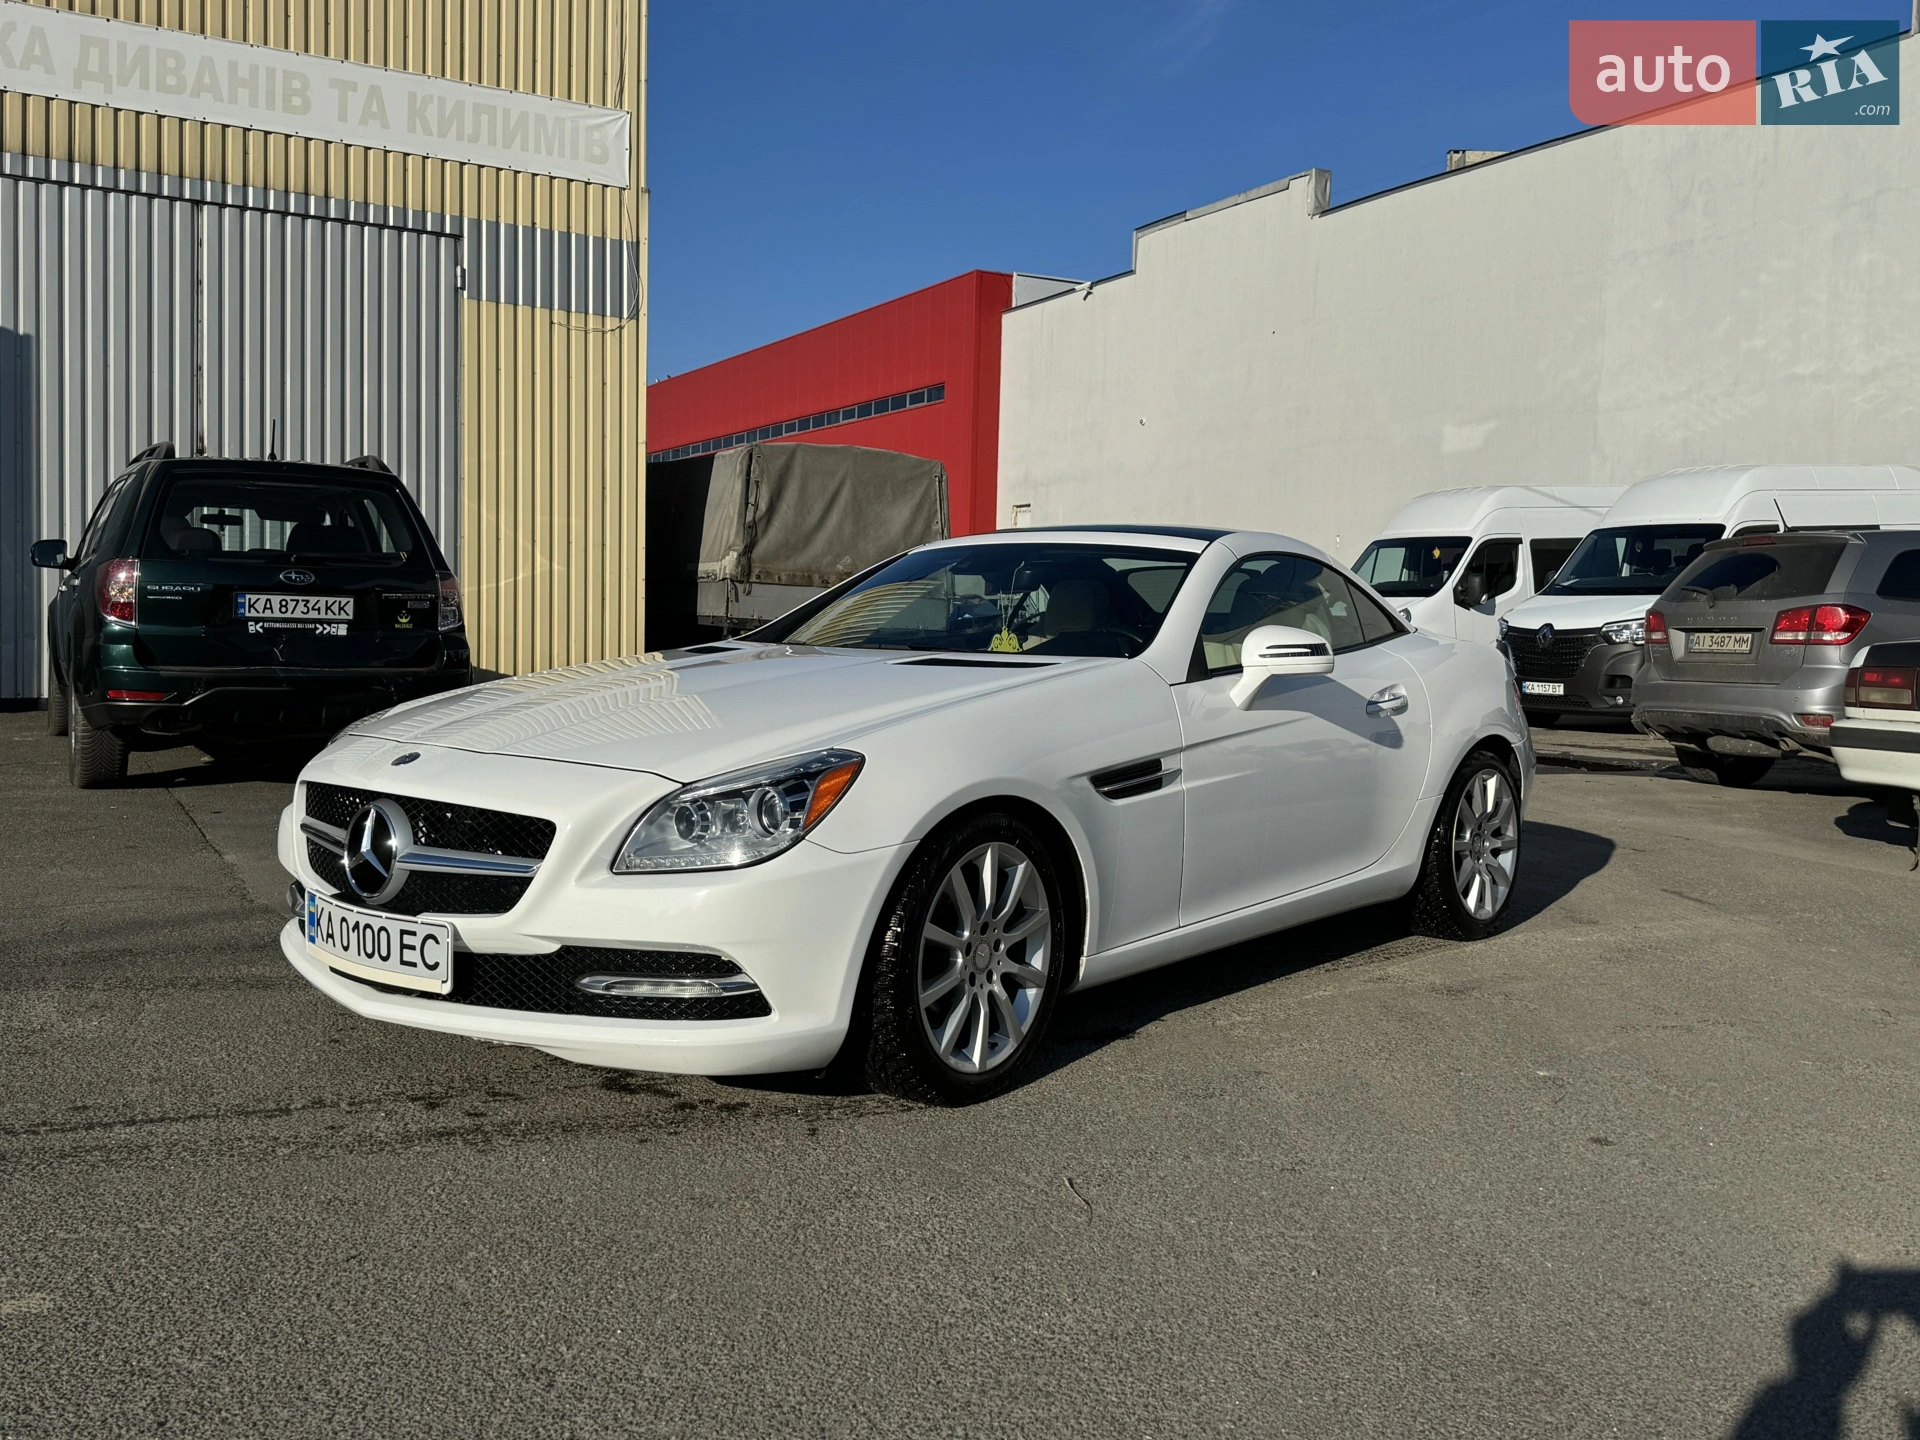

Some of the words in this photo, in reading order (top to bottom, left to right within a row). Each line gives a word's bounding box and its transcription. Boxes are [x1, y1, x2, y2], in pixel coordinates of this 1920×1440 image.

[72, 34, 312, 116] ДИВАНІВ
[327, 76, 391, 130] ТА
[406, 90, 610, 165] КИЛИМІВ
[247, 597, 275, 615] KA
[278, 598, 321, 616] 8734
[324, 599, 351, 617] KK
[1694, 635, 1706, 648] AI
[1708, 635, 1732, 648] 3487
[1733, 635, 1750, 649] MM
[1537, 684, 1550, 693] 1157
[1551, 684, 1562, 693] BT
[316, 903, 336, 948] KA
[339, 916, 392, 963] 0100
[399, 928, 441, 972] EC
